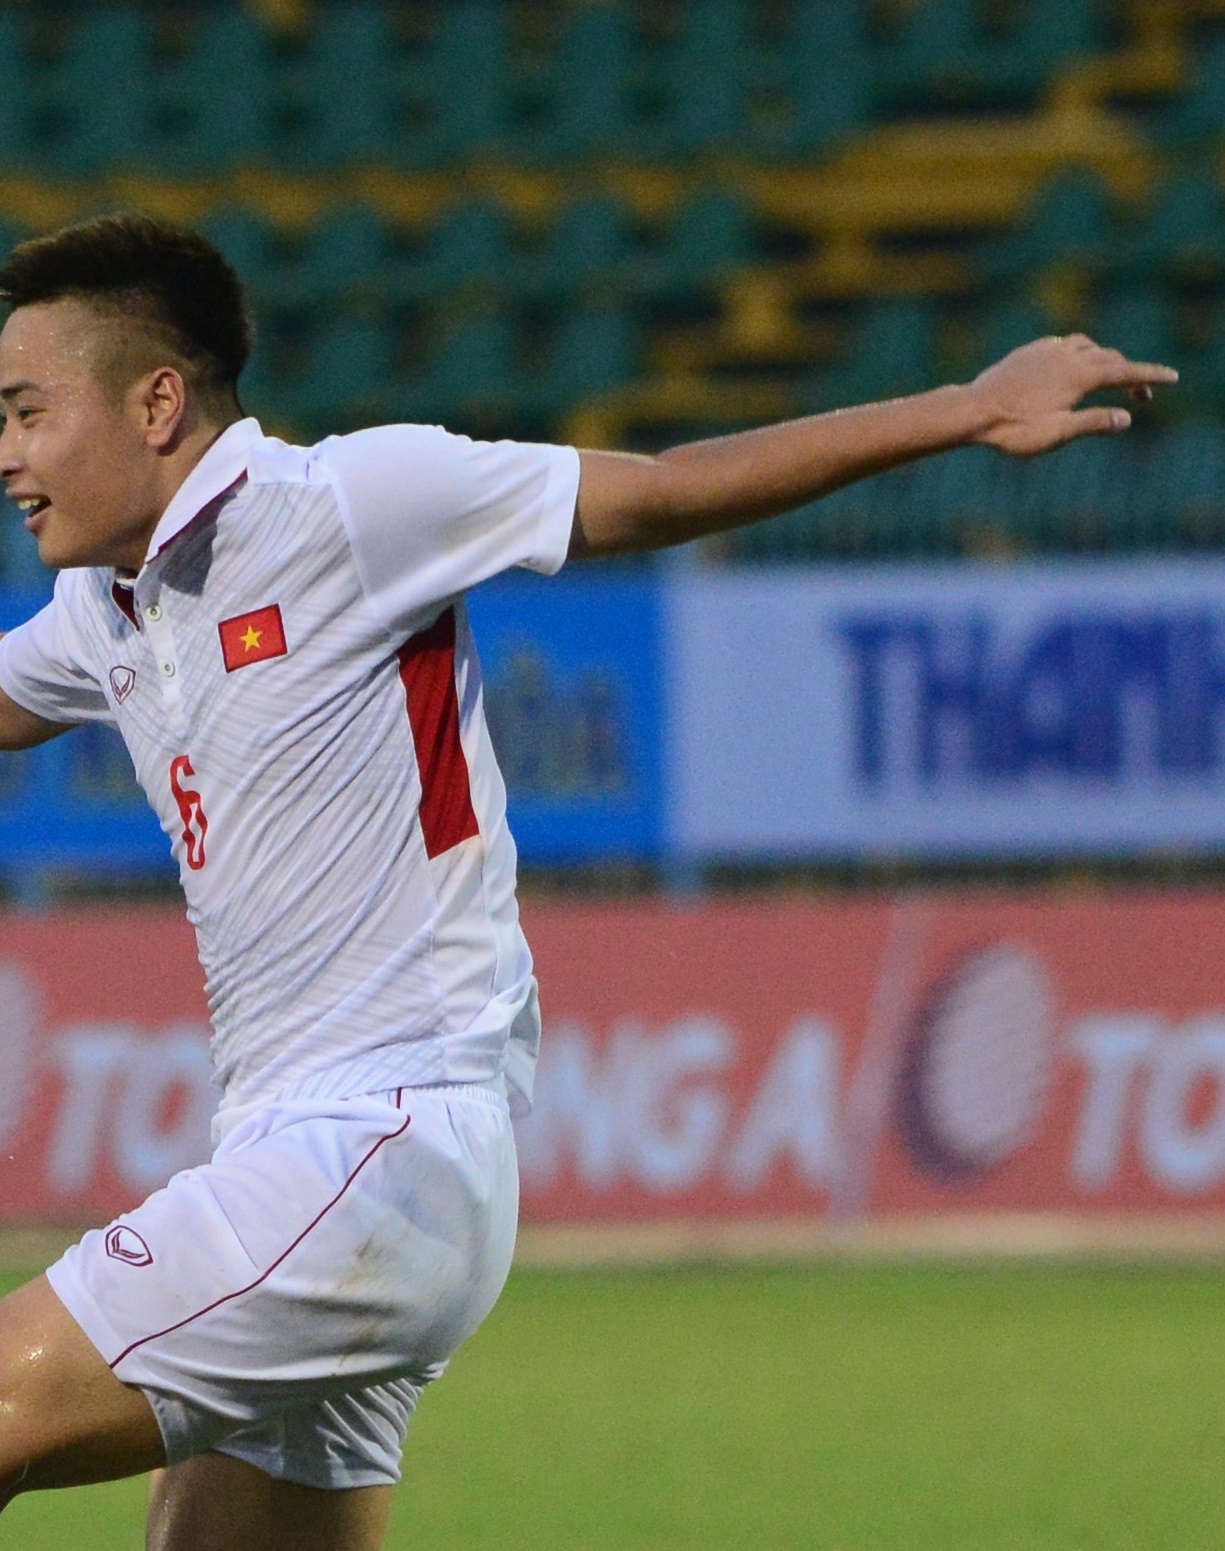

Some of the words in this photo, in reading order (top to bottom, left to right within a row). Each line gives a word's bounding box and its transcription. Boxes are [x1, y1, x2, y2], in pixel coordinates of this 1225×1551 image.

[170, 755, 208, 870] 6
[48, 1016, 216, 1191] TO
[1066, 1010, 1225, 1188] TO
